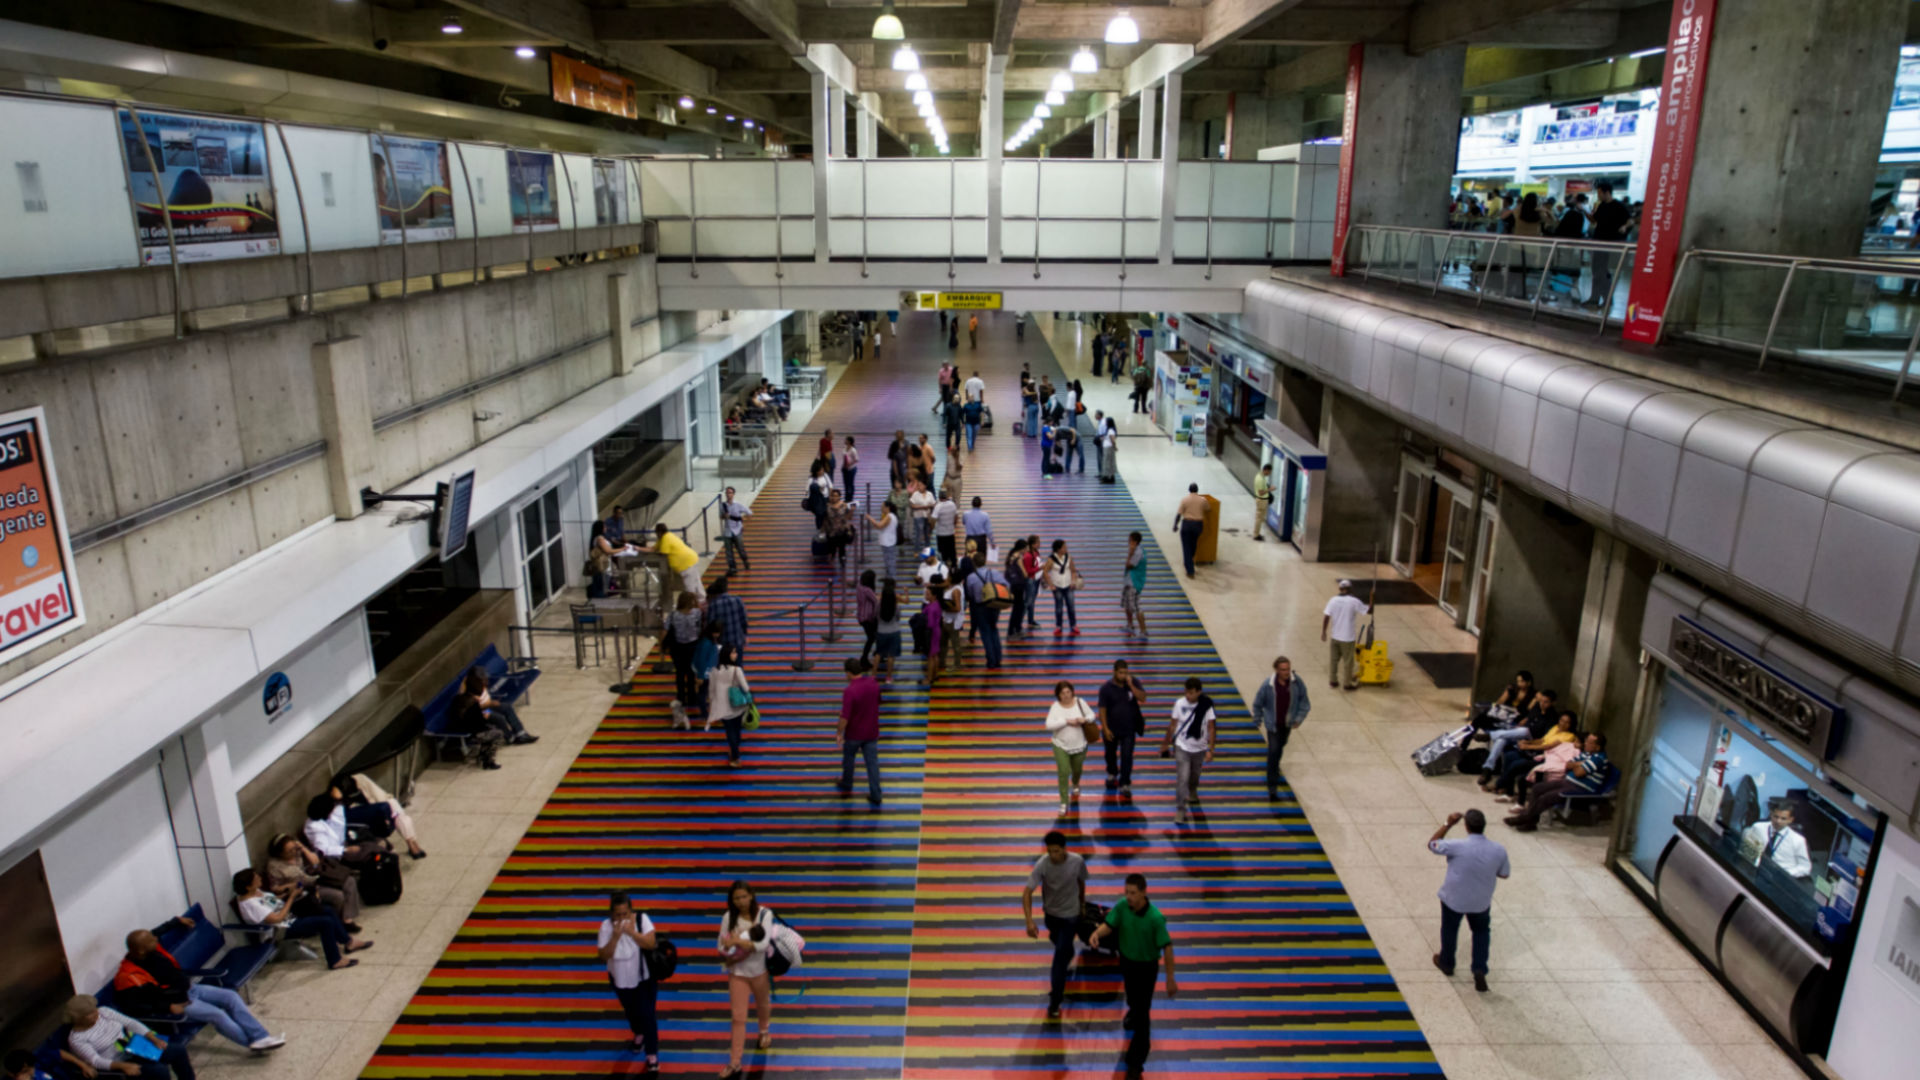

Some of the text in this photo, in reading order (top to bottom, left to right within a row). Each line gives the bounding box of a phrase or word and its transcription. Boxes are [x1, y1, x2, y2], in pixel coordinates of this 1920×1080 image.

[1664, 15, 1703, 231] de los sectores productivos
[1643, 162, 1670, 273] Invertimos
